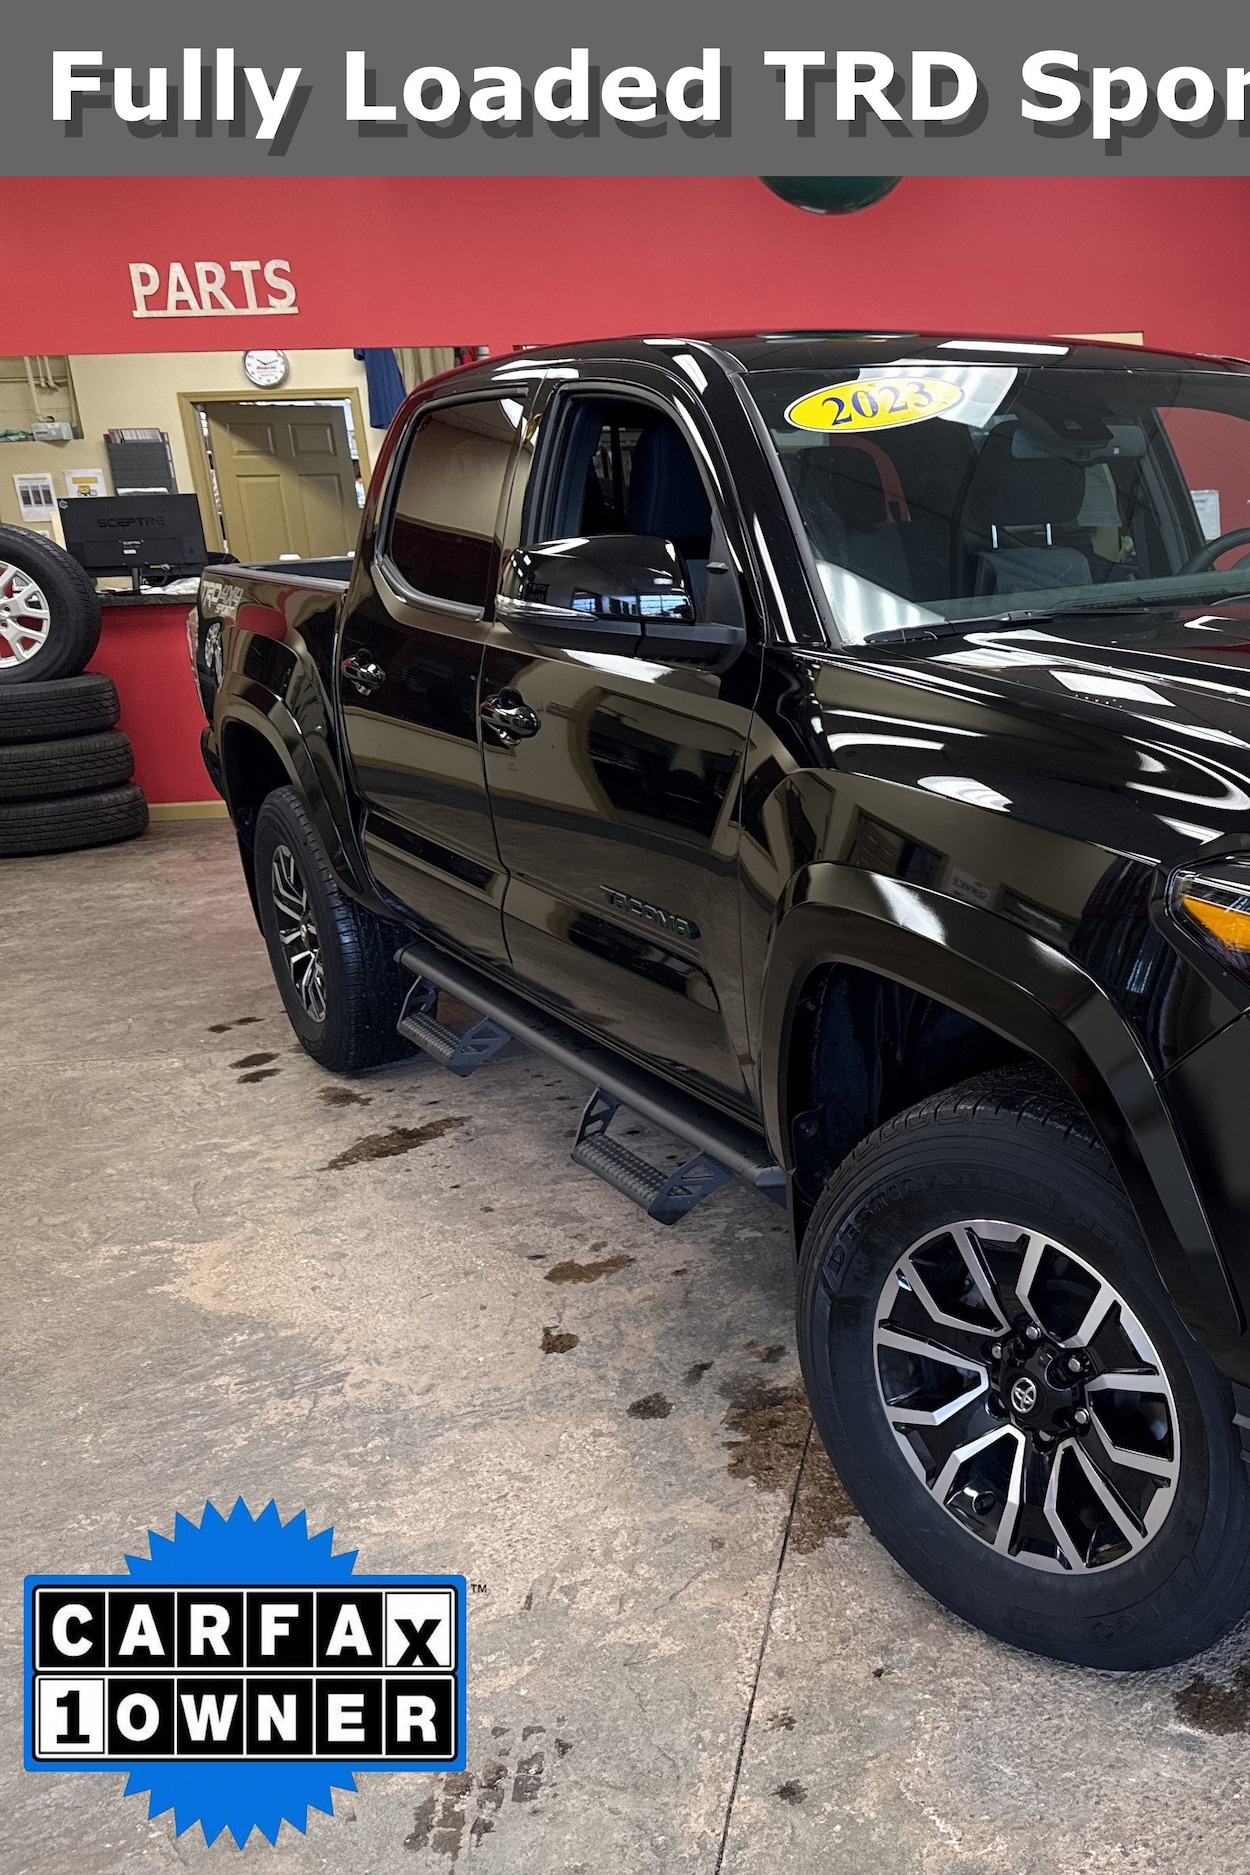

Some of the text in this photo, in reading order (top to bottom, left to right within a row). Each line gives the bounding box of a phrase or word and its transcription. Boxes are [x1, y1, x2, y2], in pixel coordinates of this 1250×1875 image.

[129, 259, 297, 312] PARTS
[821, 381, 934, 426] 2023
[97, 516, 166, 529] SCEPTRE
[599, 884, 702, 940] TACOMA
